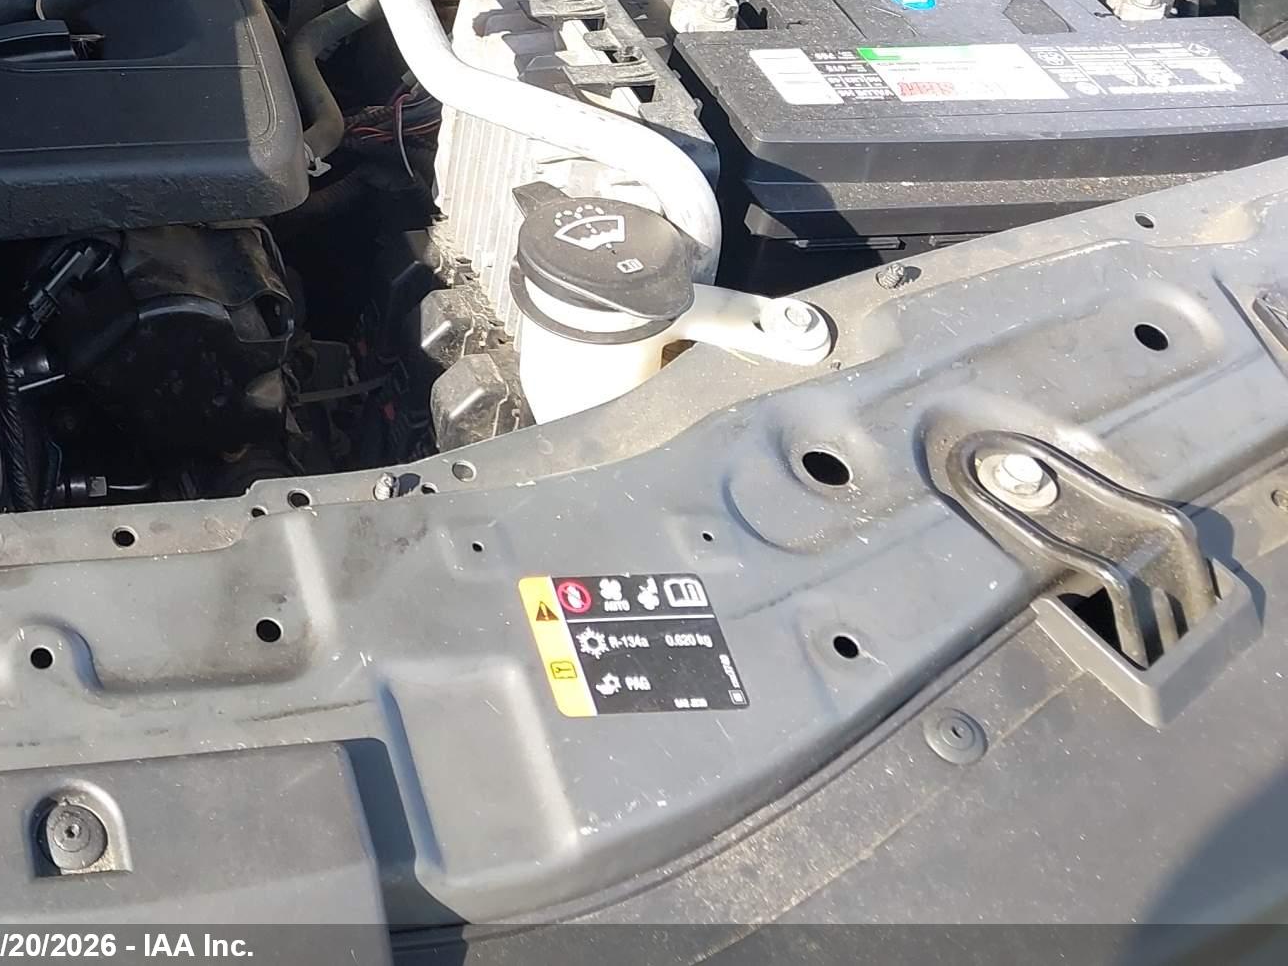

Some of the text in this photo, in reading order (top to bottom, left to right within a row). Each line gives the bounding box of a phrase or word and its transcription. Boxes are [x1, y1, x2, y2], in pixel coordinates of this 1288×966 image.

[608, 635, 650, 648] R-134a
[695, 634, 713, 648] kg
[625, 676, 651, 691] PAG
